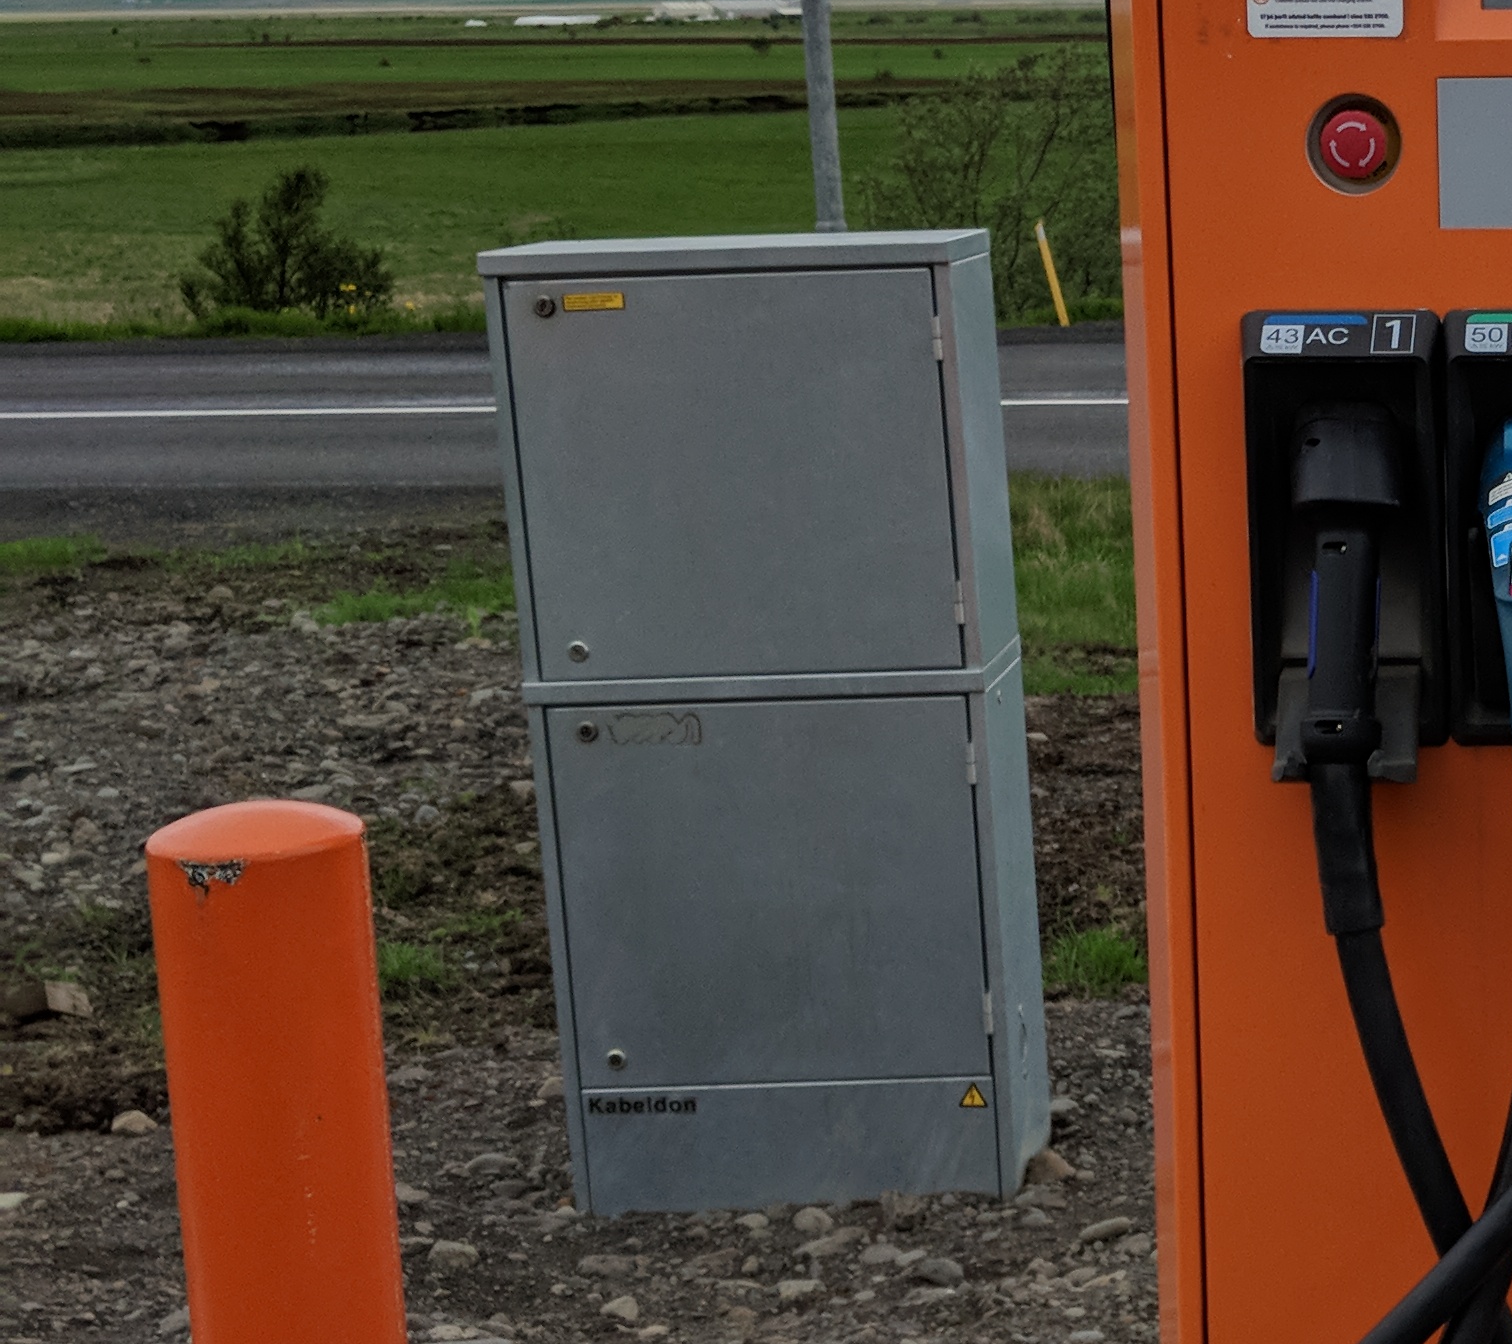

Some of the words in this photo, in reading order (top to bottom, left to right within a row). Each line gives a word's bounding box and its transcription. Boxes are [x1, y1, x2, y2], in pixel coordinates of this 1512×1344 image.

[1266, 328, 1299, 344] 43
[1305, 327, 1349, 344] AC
[1385, 319, 1402, 349] 1
[1471, 327, 1504, 343] 50
[589, 1096, 696, 1114] Kabeldon
